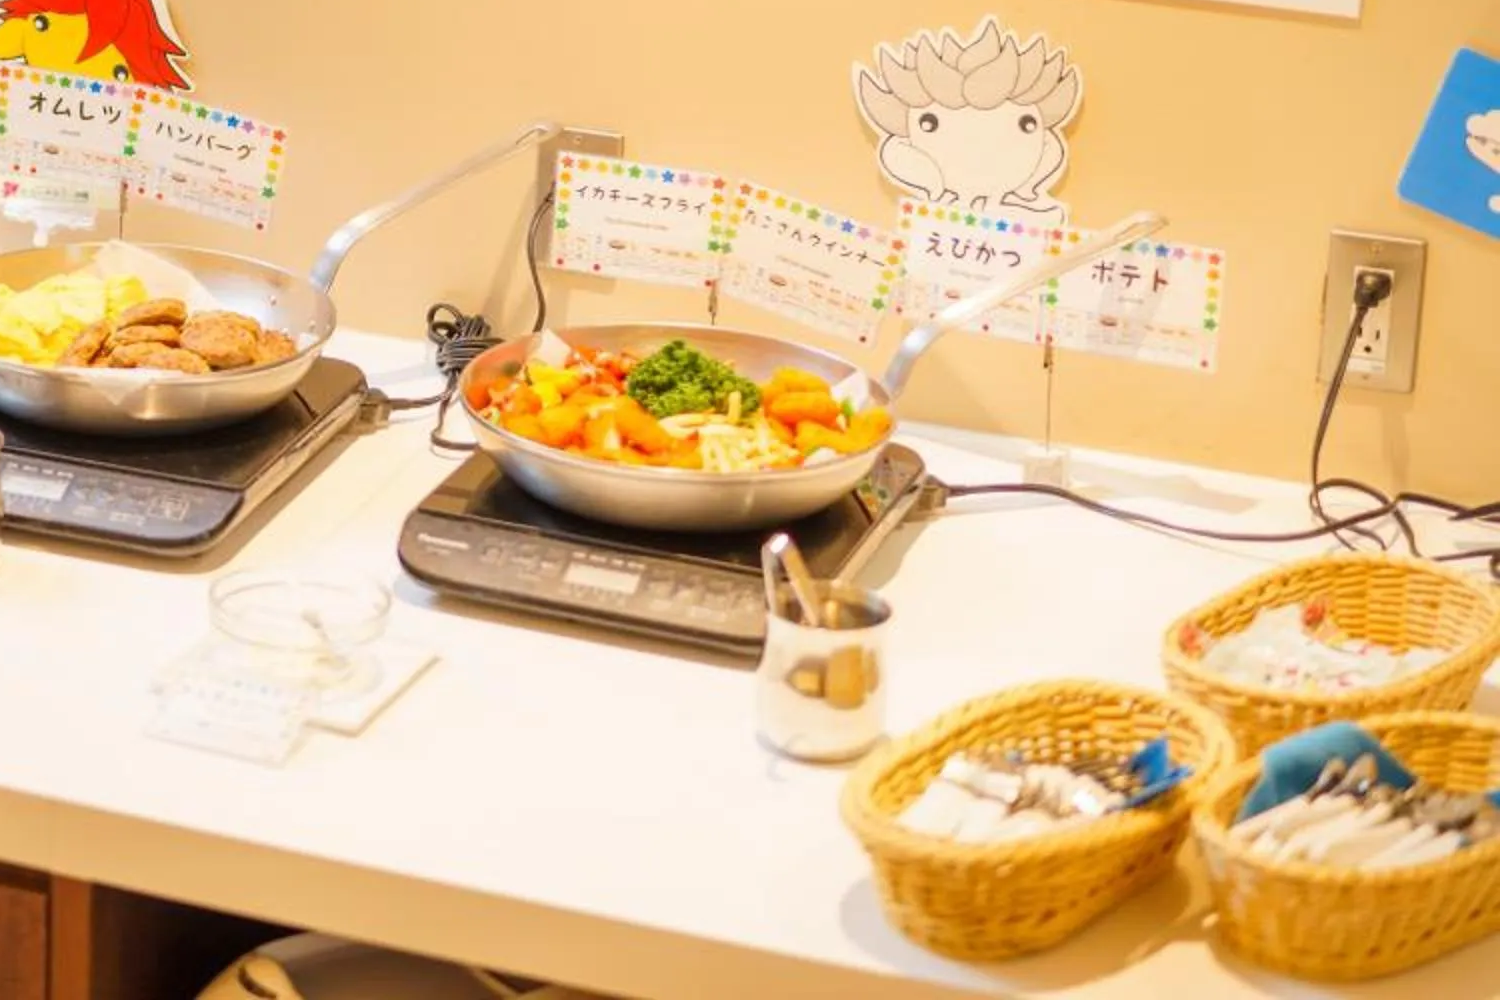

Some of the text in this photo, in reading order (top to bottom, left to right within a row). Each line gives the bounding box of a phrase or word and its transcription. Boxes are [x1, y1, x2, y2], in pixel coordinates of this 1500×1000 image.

[28, 91, 121, 125] オムレツ
[155, 121, 257, 161] ハンバーグ
[574, 184, 708, 217] イカチーズフライ
[744, 208, 886, 268] たこさんウインナー
[925, 231, 1021, 268] えびかつ
[1091, 259, 1169, 293] ポテト
